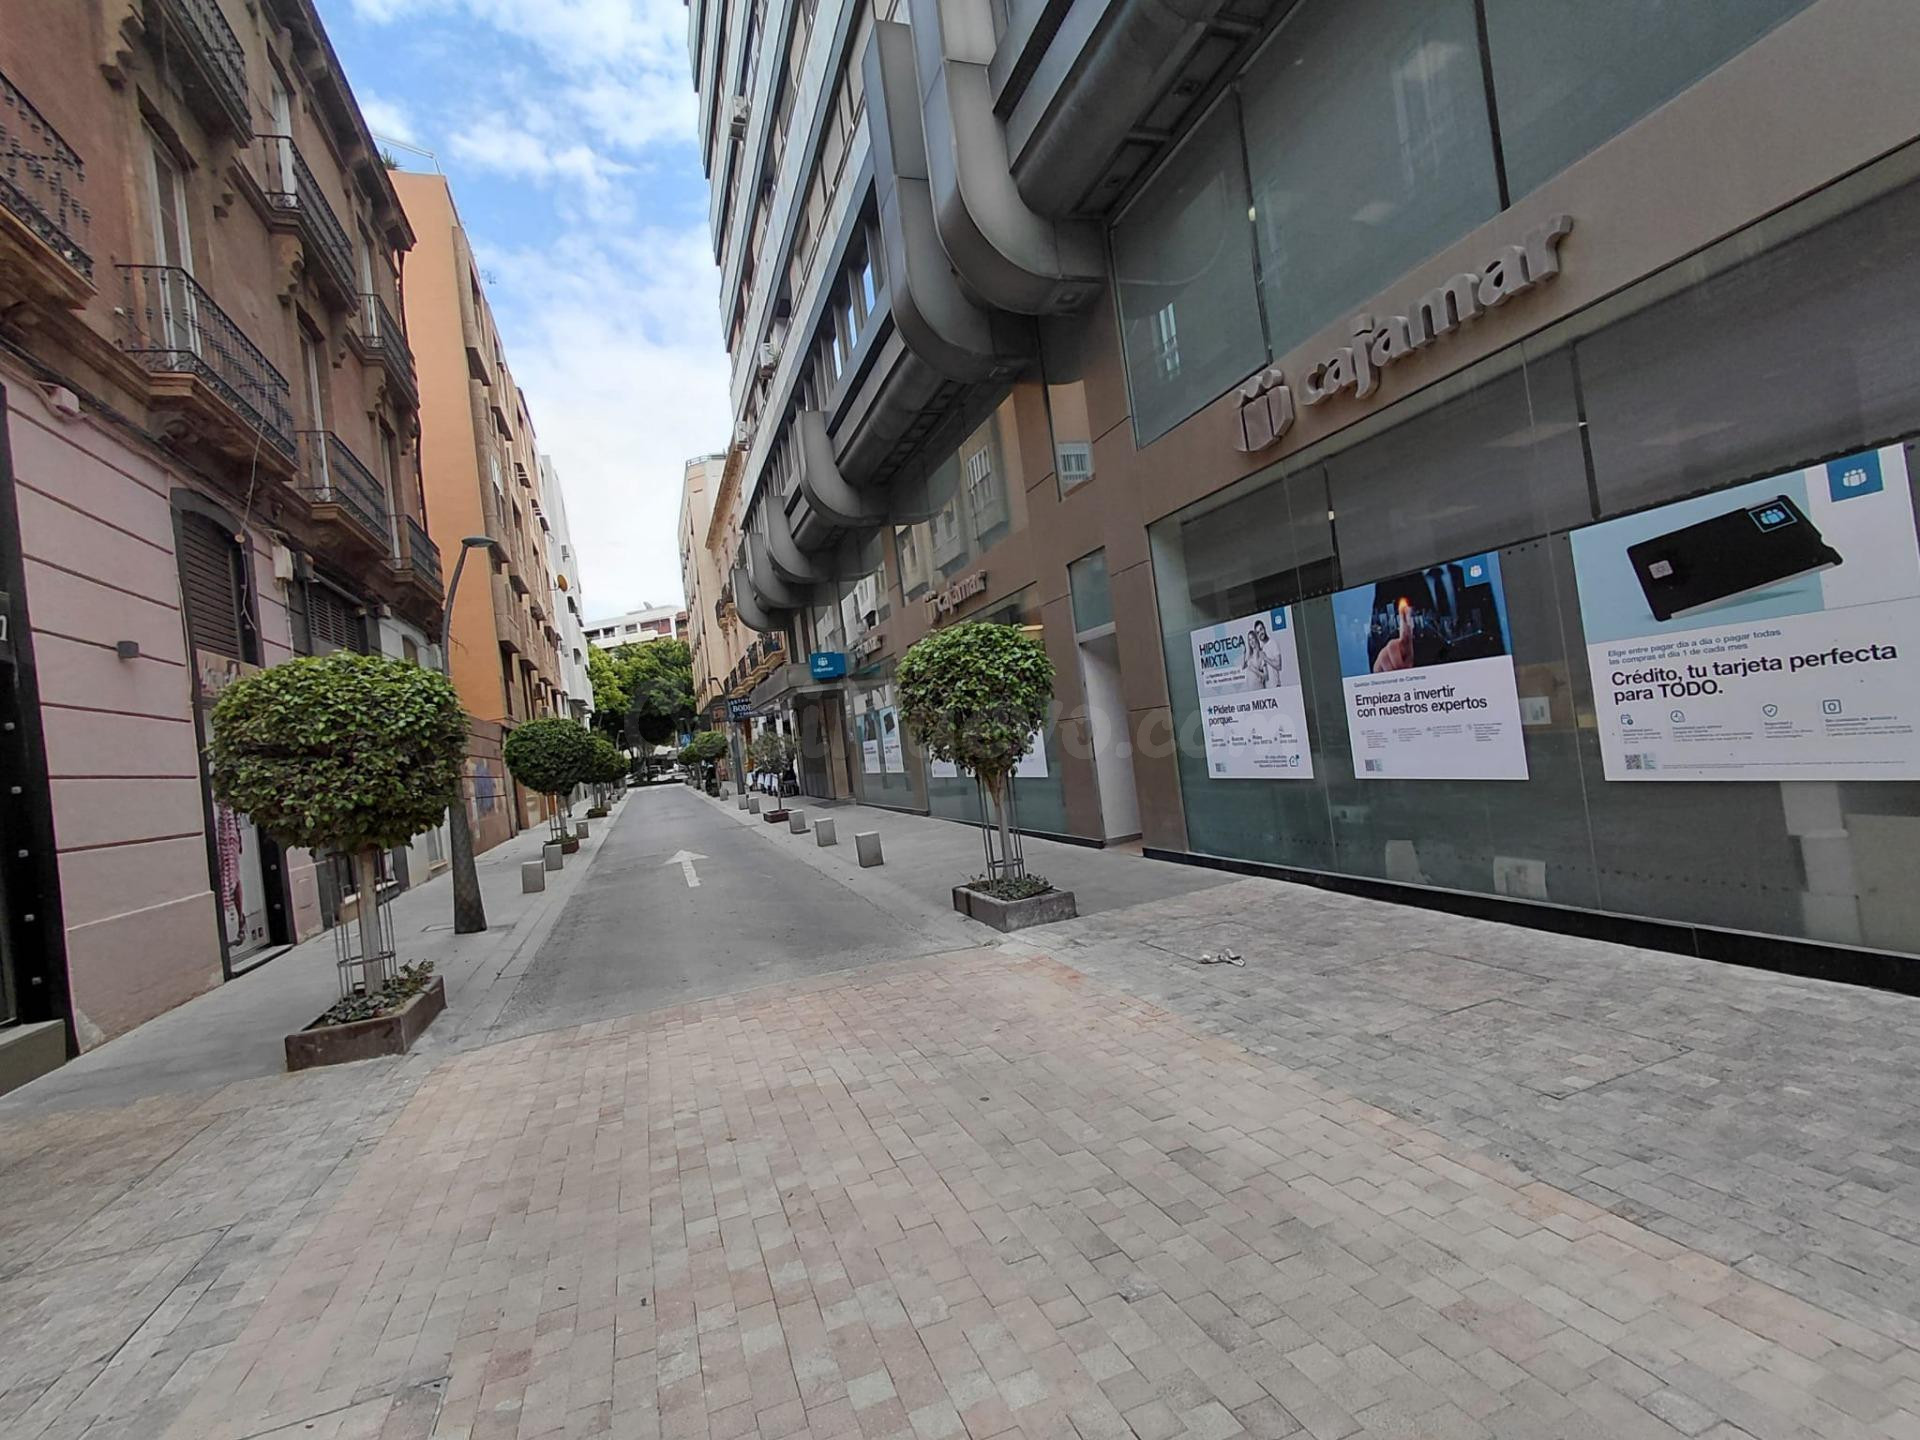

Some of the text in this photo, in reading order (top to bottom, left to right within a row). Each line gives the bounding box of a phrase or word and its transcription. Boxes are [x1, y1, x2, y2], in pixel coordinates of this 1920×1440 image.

[1301, 214, 1574, 406] cajamar
[1199, 634, 1246, 656] HIPOTECA
[1723, 633, 1750, 645] pagar
[1752, 628, 1782, 638] todas
[1703, 644, 1726, 654] cada
[1727, 643, 1748, 651] mes
[1200, 653, 1230, 670] MIXTA
[1611, 643, 1898, 686] Crédito, tu tarjeta perfecta
[1355, 684, 1456, 708] Empieza a invertir
[1613, 679, 1723, 705] para TODO.
[1236, 702, 1251, 712] una
[1251, 698, 1278, 711] MIXTA
[1357, 696, 1487, 719] con nuestros expertos
